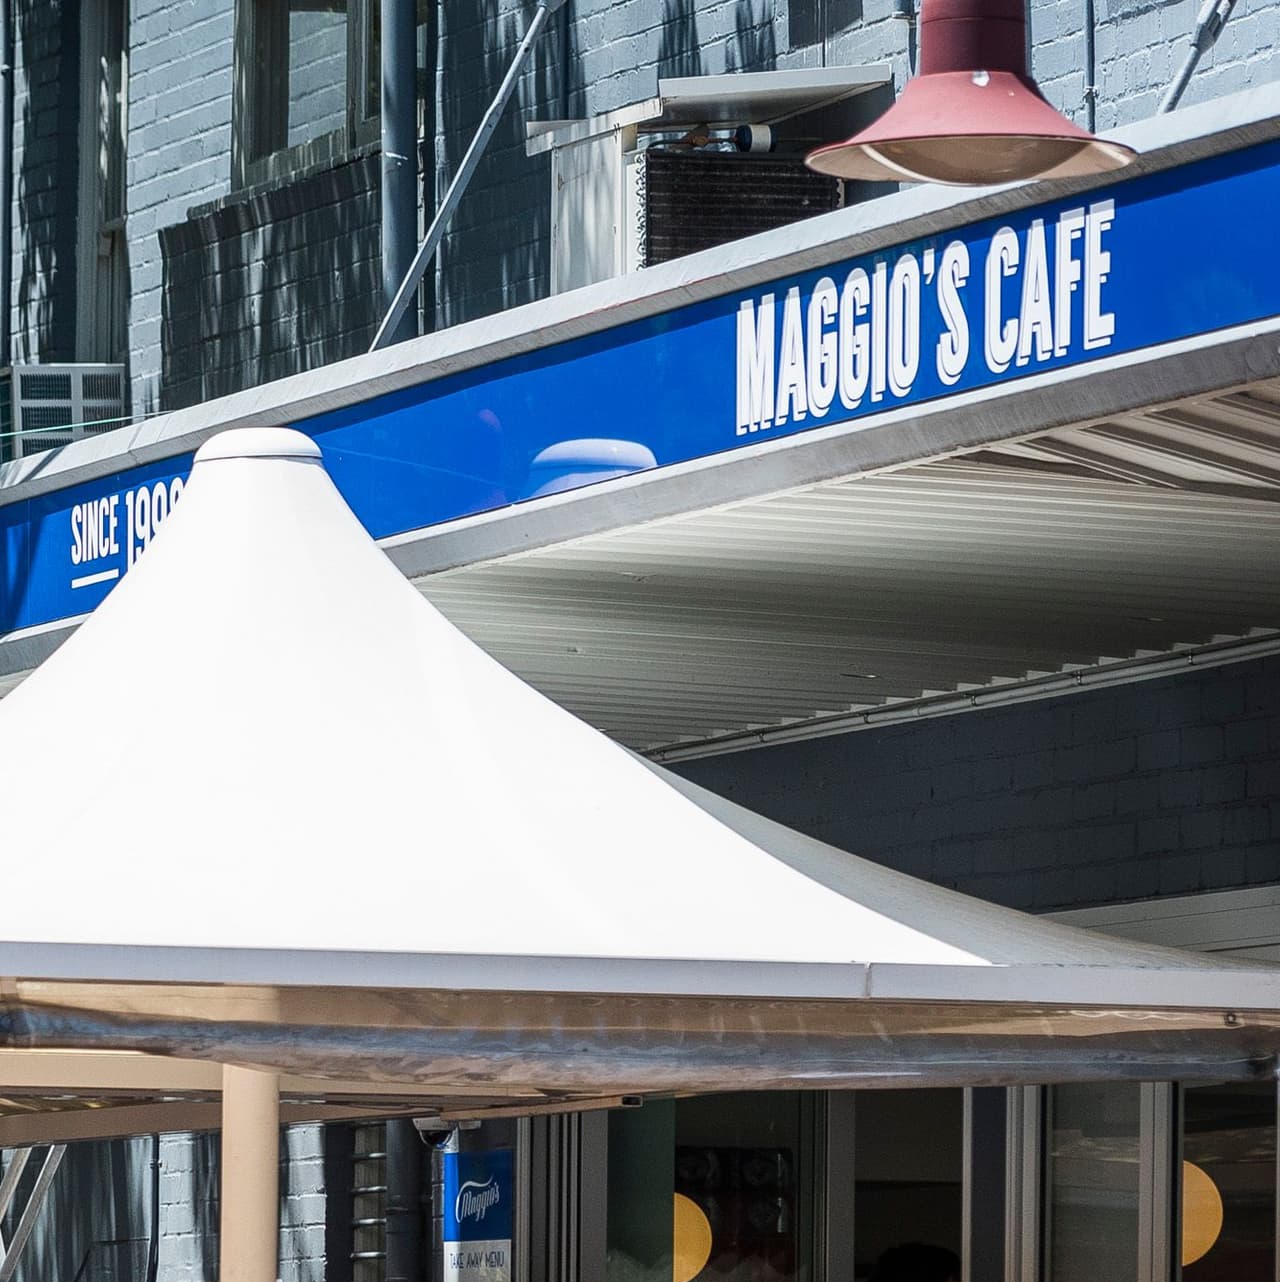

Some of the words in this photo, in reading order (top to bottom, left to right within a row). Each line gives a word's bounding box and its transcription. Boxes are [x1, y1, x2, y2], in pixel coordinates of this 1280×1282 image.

[736, 240, 970, 436] MAGGIO'S
[984, 198, 1116, 374] CAFE
[71, 494, 120, 565] SINCE
[456, 1174, 500, 1223] Maggio's
[450, 1252, 464, 1269] TAKE
[467, 1251, 483, 1268] AWAY
[485, 1251, 505, 1268] MENU
